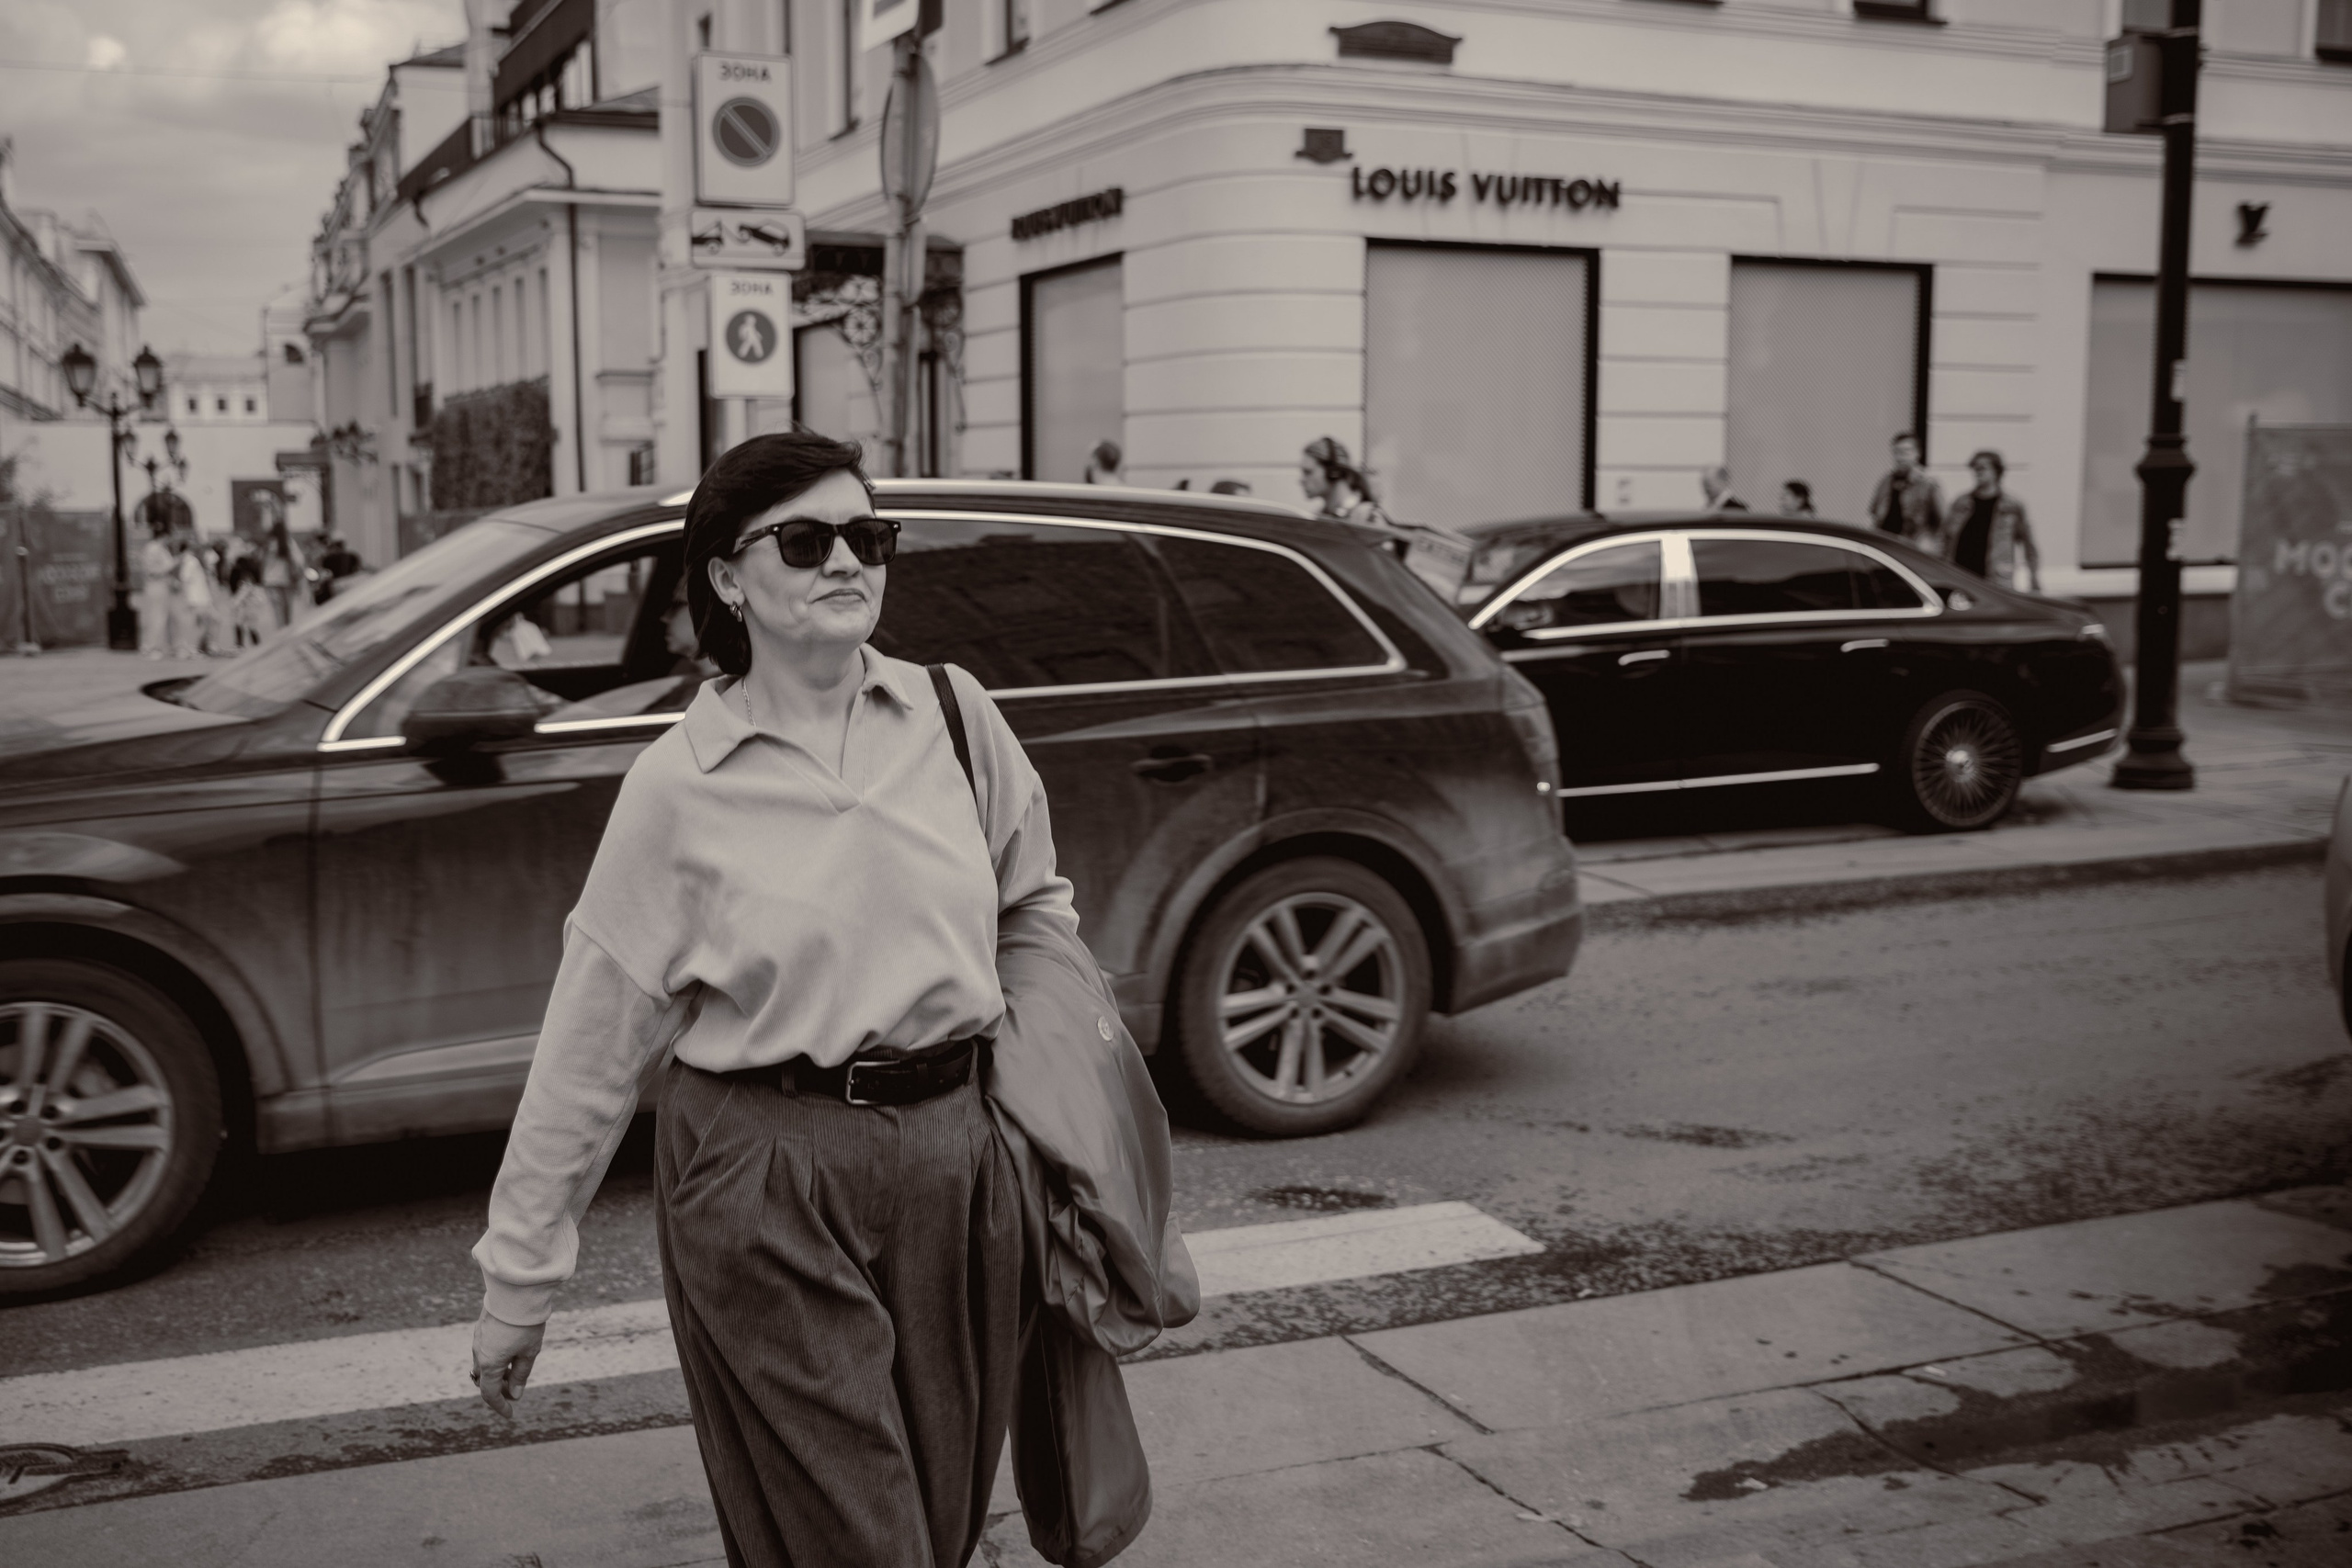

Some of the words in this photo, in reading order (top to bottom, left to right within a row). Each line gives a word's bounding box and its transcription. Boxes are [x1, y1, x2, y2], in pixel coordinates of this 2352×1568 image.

[719, 61, 772, 84] ЗОНА
[1351, 165, 1457, 203] LOUIS
[1472, 173, 1619, 209] VUITTON
[729, 278, 774, 297] ЗОНА
